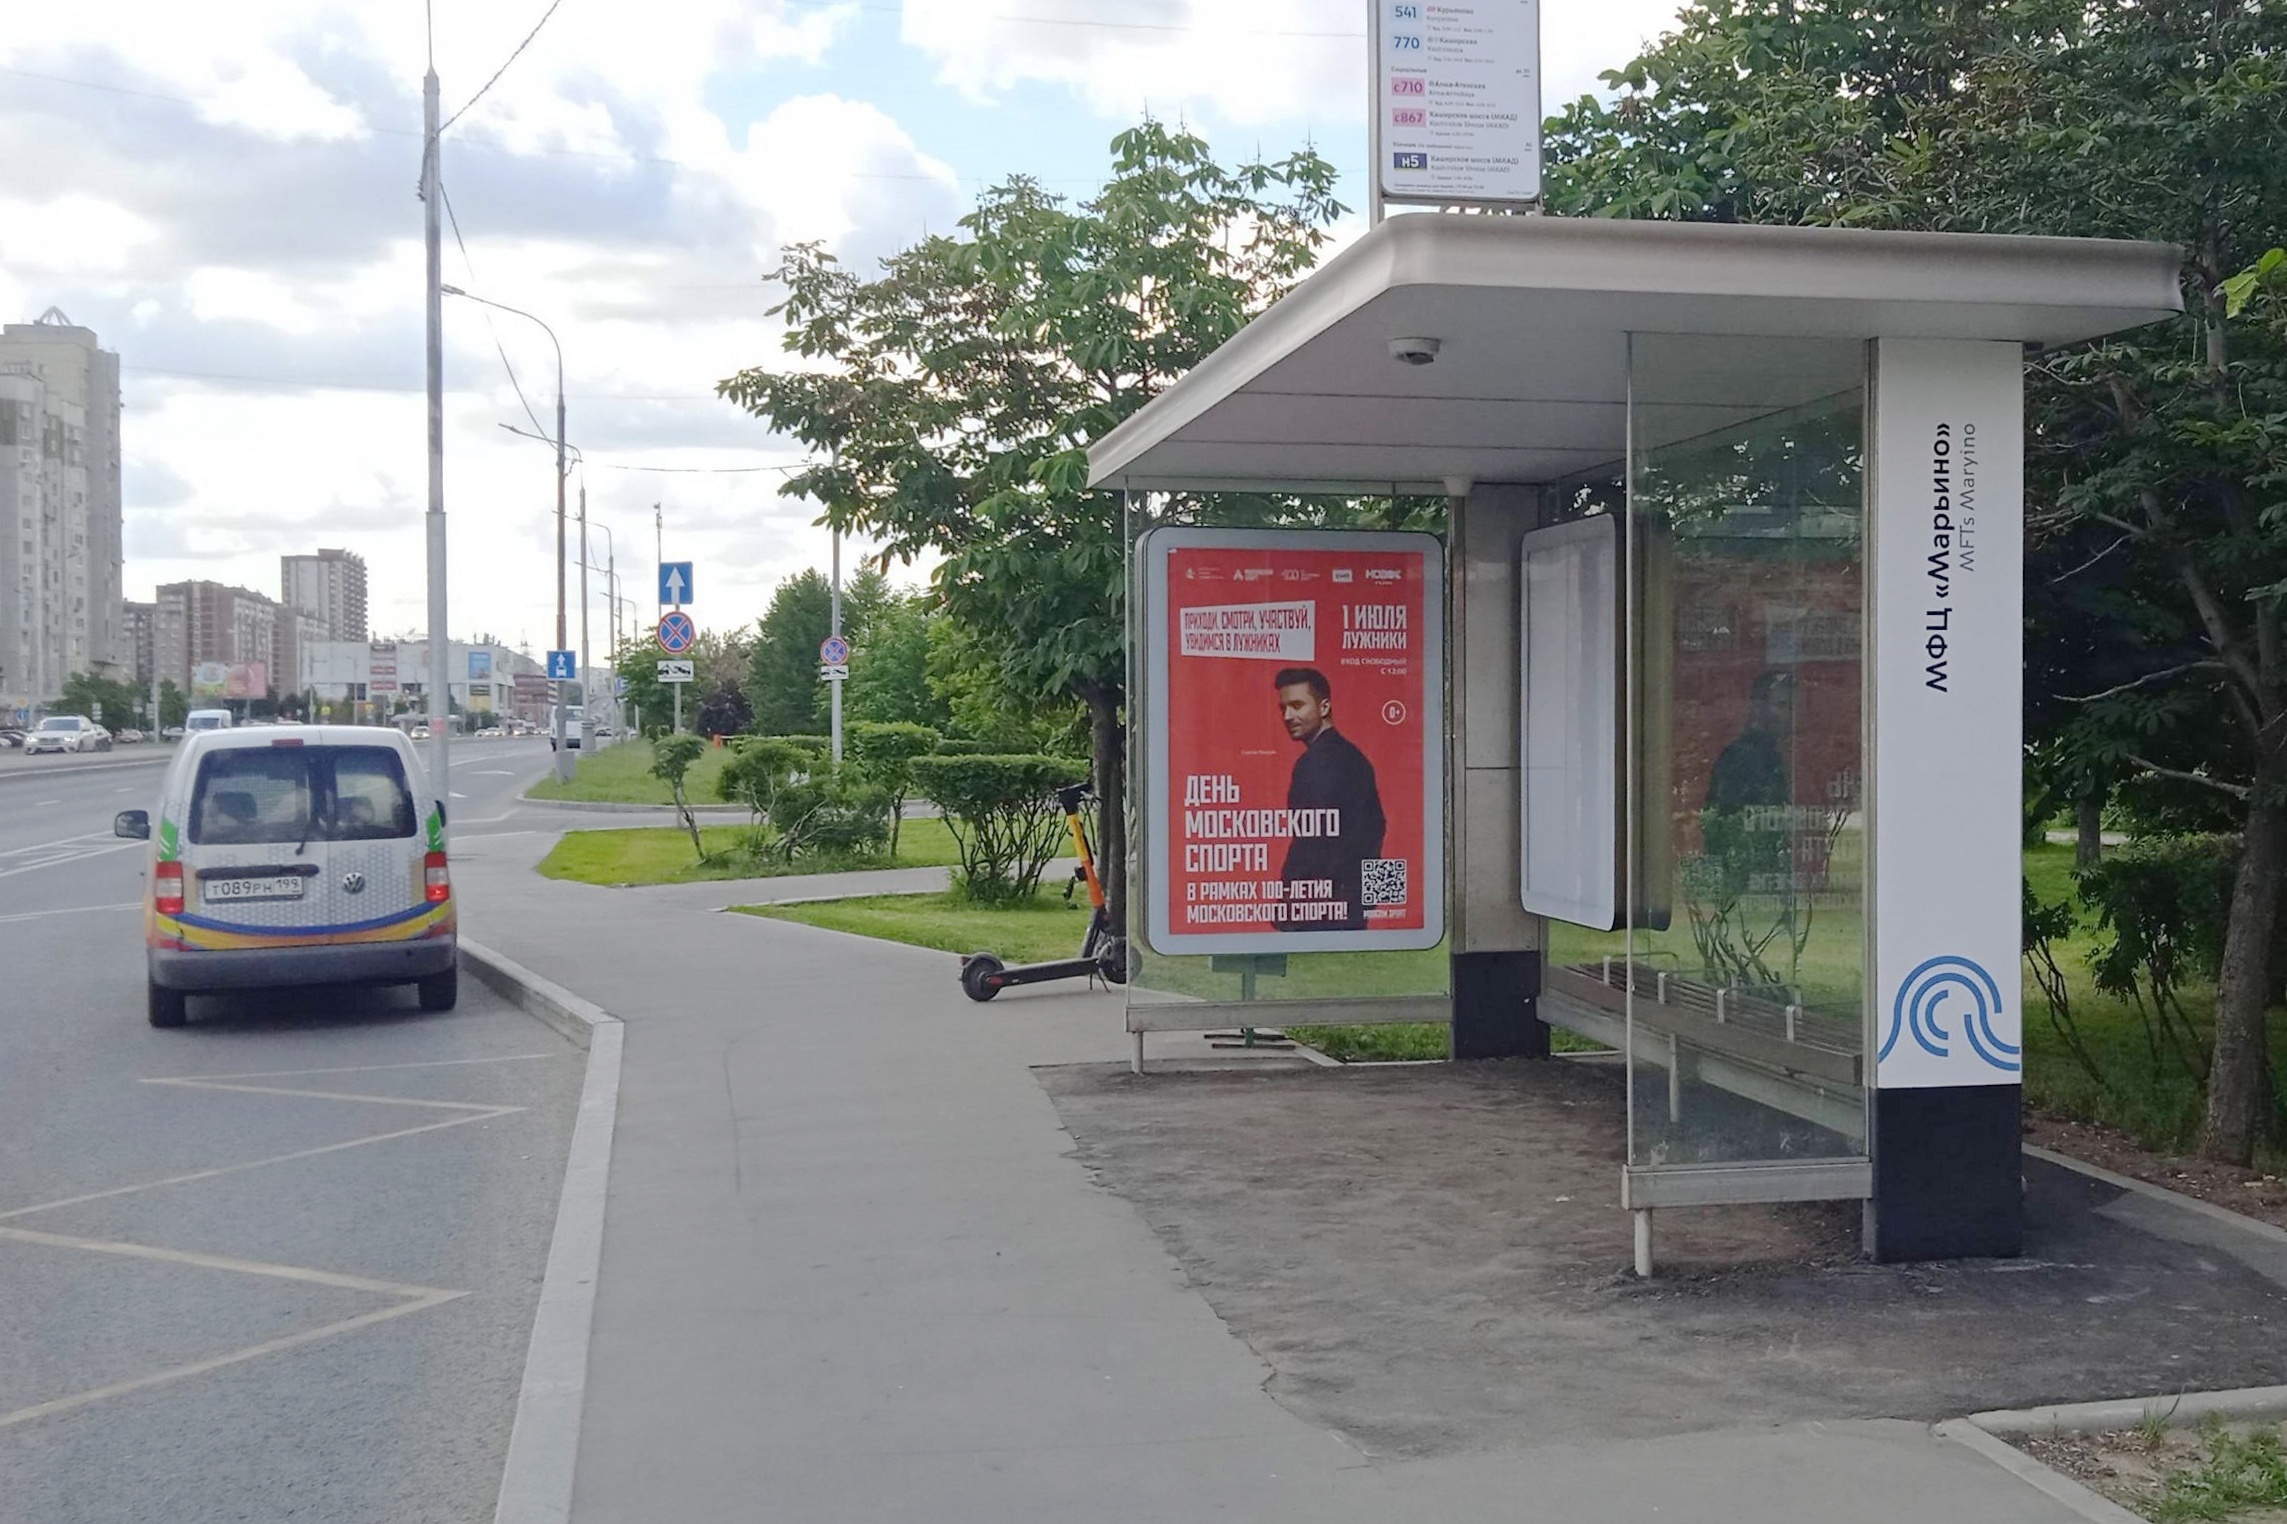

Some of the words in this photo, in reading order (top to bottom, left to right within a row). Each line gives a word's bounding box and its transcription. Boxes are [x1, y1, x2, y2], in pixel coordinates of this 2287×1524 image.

[1395, 5, 1416, 19] 541
[1394, 36, 1420, 49] 770
[1959, 423, 1978, 510] Maryino
[1927, 422, 1955, 598] «Марьино»
[1959, 516, 1975, 572] MFTs
[1222, 610, 1257, 631] СМОТРИ,
[1260, 604, 1311, 632] УЧАСТВУЙ,
[1342, 605, 1349, 629] 1
[1354, 605, 1407, 629] ИЮЛЯ
[1185, 633, 1225, 651] УВИДИМСЯ
[1225, 633, 1231, 651] В
[1233, 633, 1281, 652] ЛУЖНИКАХ
[1342, 631, 1407, 649] ЛУЖНИКИ
[1925, 607, 1953, 693] МФЦ
[1184, 775, 1240, 807] ДЕНЬ
[1185, 808, 1340, 839] МОСКОВСКОГО
[1185, 843, 1268, 873] СПОРТА
[1187, 882, 1196, 901] В
[1200, 881, 1257, 900] РАМКАХ
[1261, 880, 1333, 900] 100-ЛЕТИЯ
[1187, 902, 1288, 924] МОСКОВСКОГО
[1290, 901, 1348, 922] СПОРТА!
